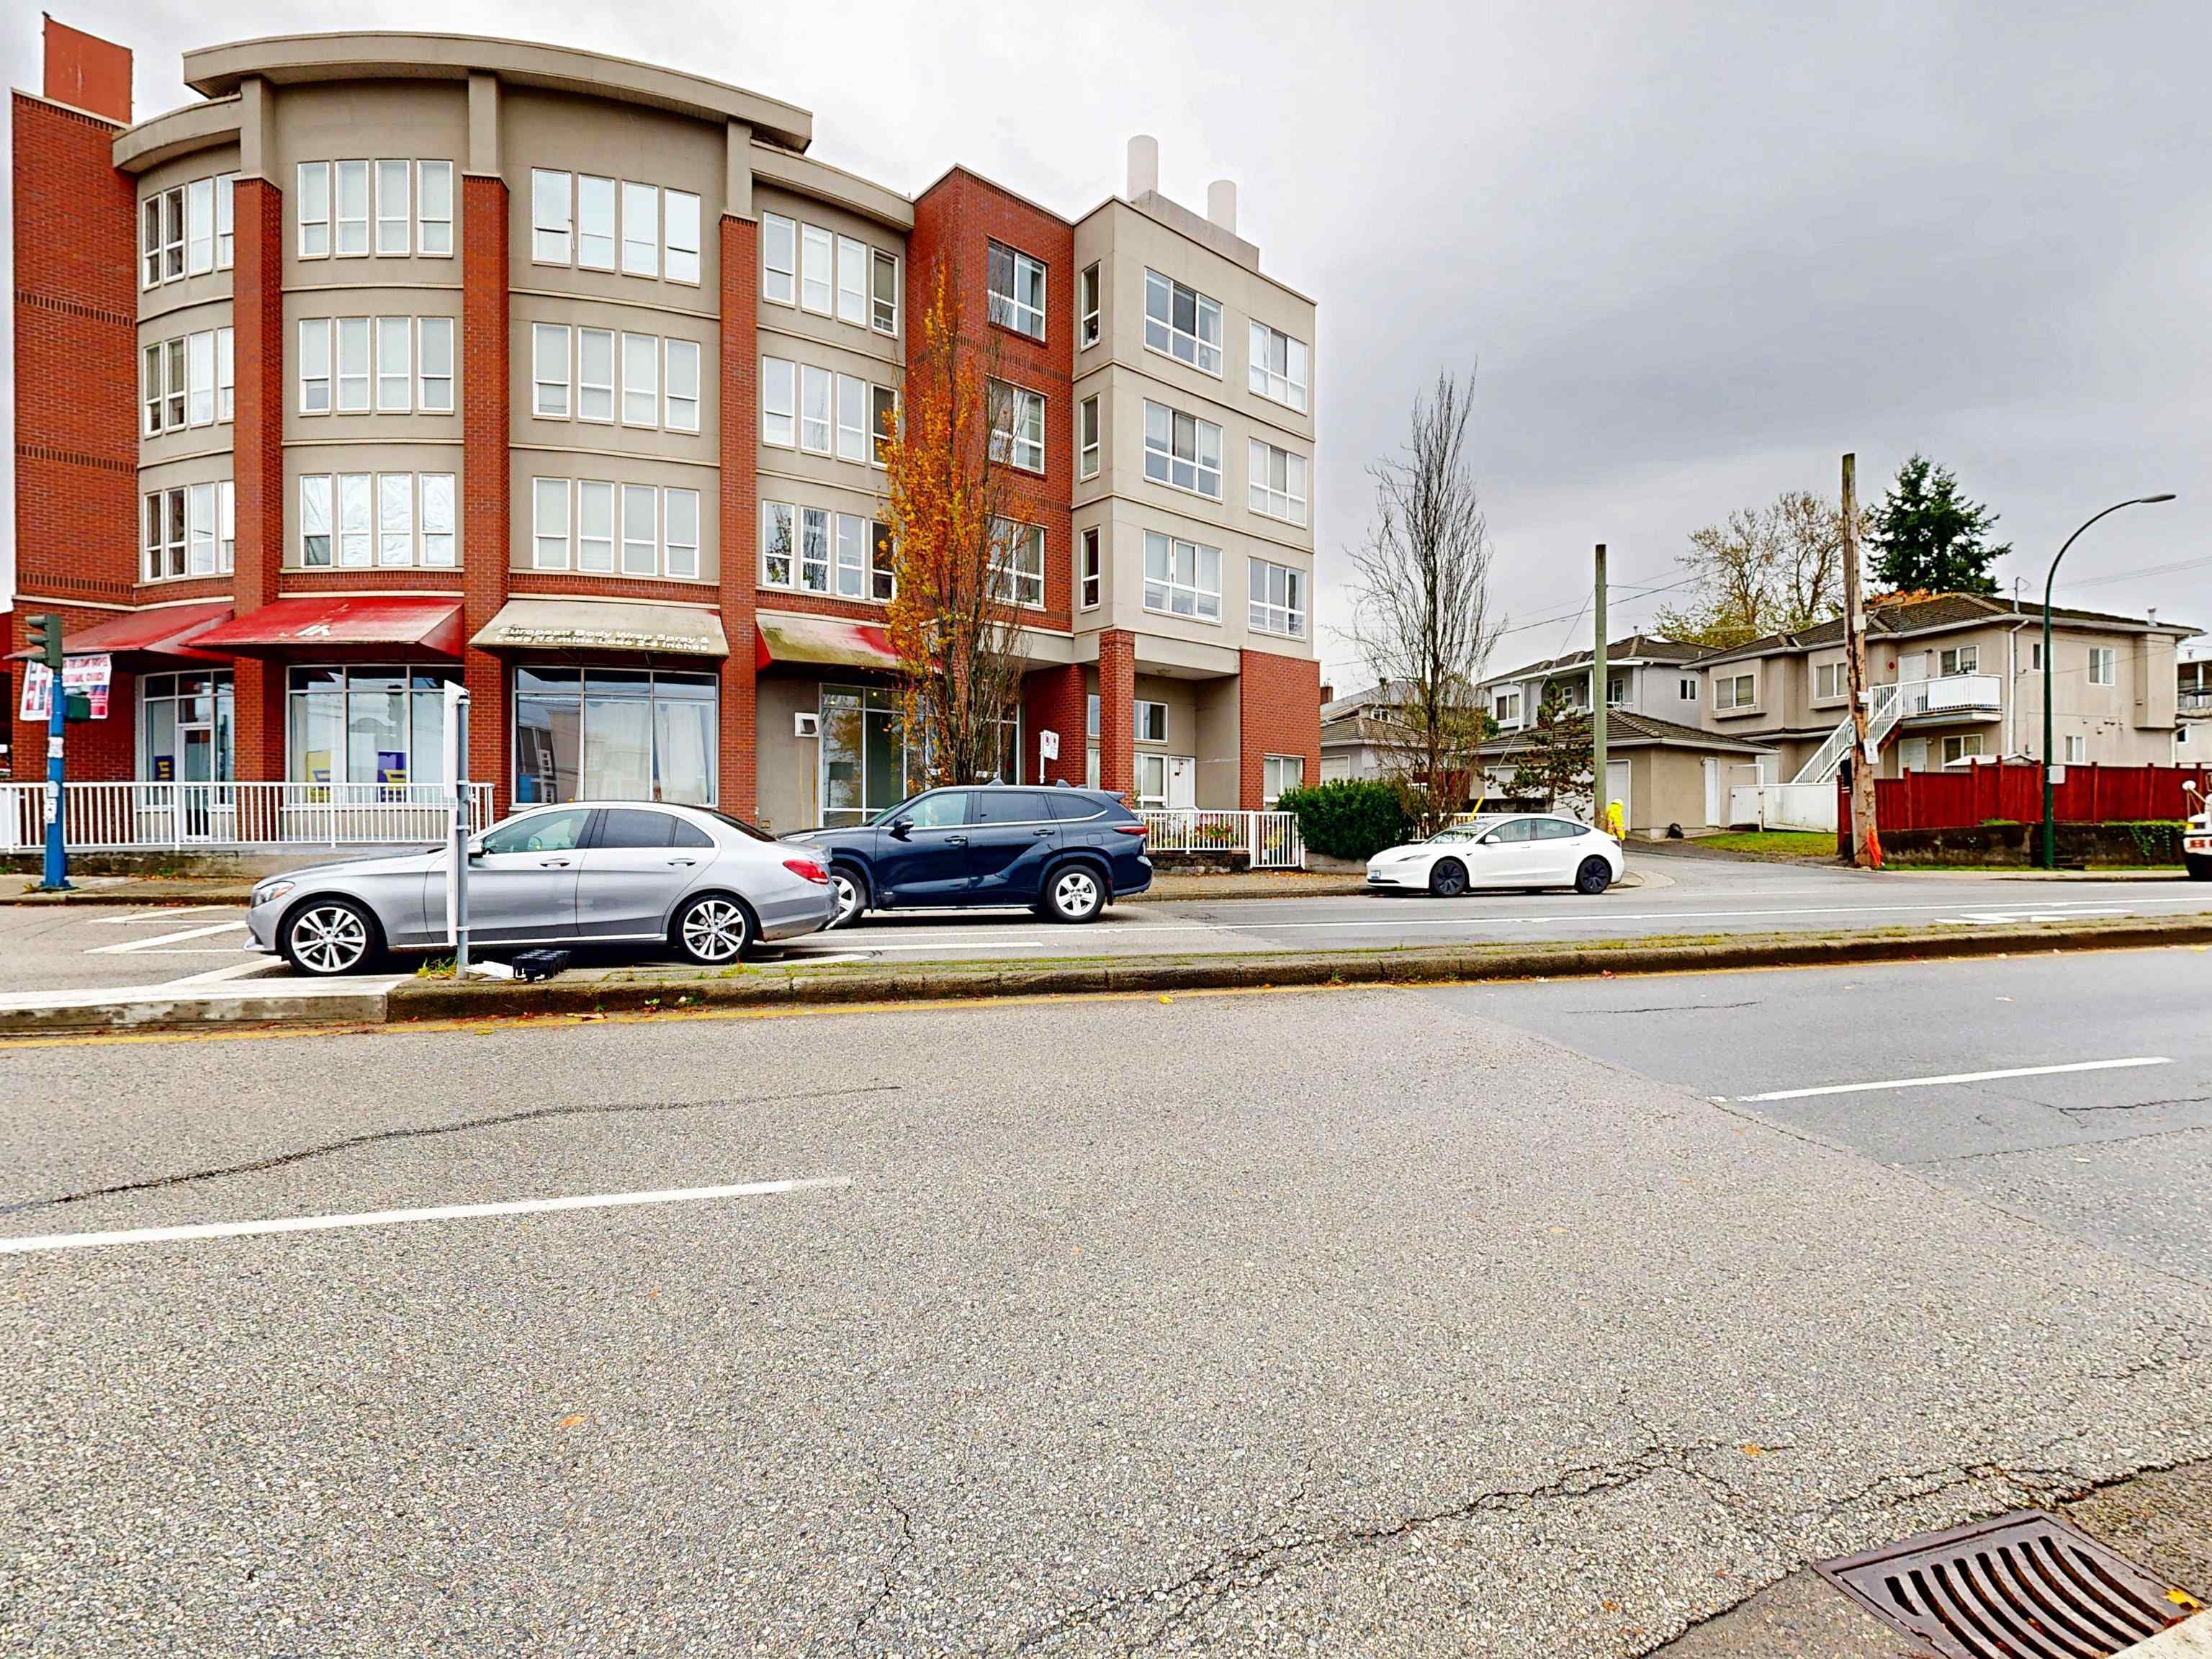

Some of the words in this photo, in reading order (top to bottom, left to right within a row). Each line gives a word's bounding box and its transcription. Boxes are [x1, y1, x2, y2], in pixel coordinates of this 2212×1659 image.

[498, 627, 571, 637] European
[574, 629, 612, 639] Body
[616, 631, 652, 642] Wrap
[656, 634, 696, 644] Spray
[597, 637, 633, 647] Lose
[2190, 840, 2212, 848] B
